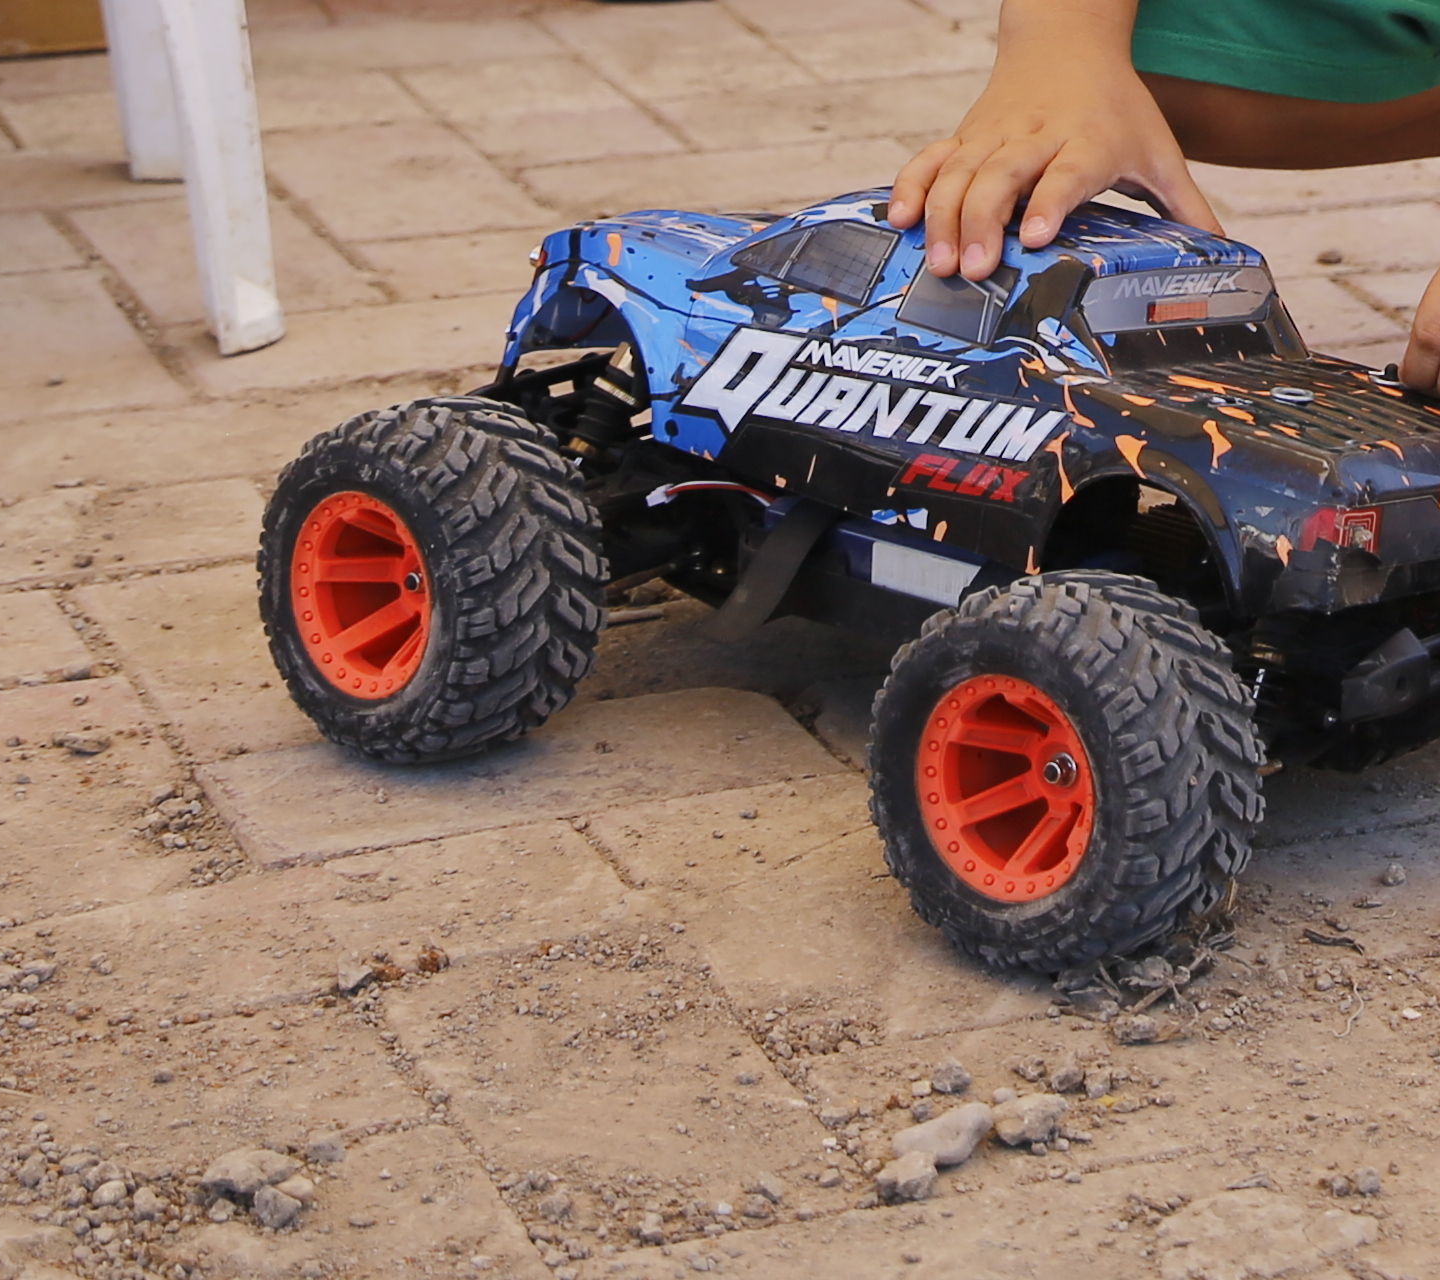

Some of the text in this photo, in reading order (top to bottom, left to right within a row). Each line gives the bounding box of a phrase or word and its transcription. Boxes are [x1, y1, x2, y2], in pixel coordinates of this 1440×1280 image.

[1112, 270, 1243, 300] MAVERICK
[795, 339, 971, 389] MAVERICK
[681, 327, 1071, 463] QUANTUM
[900, 453, 1030, 503] FLUX
